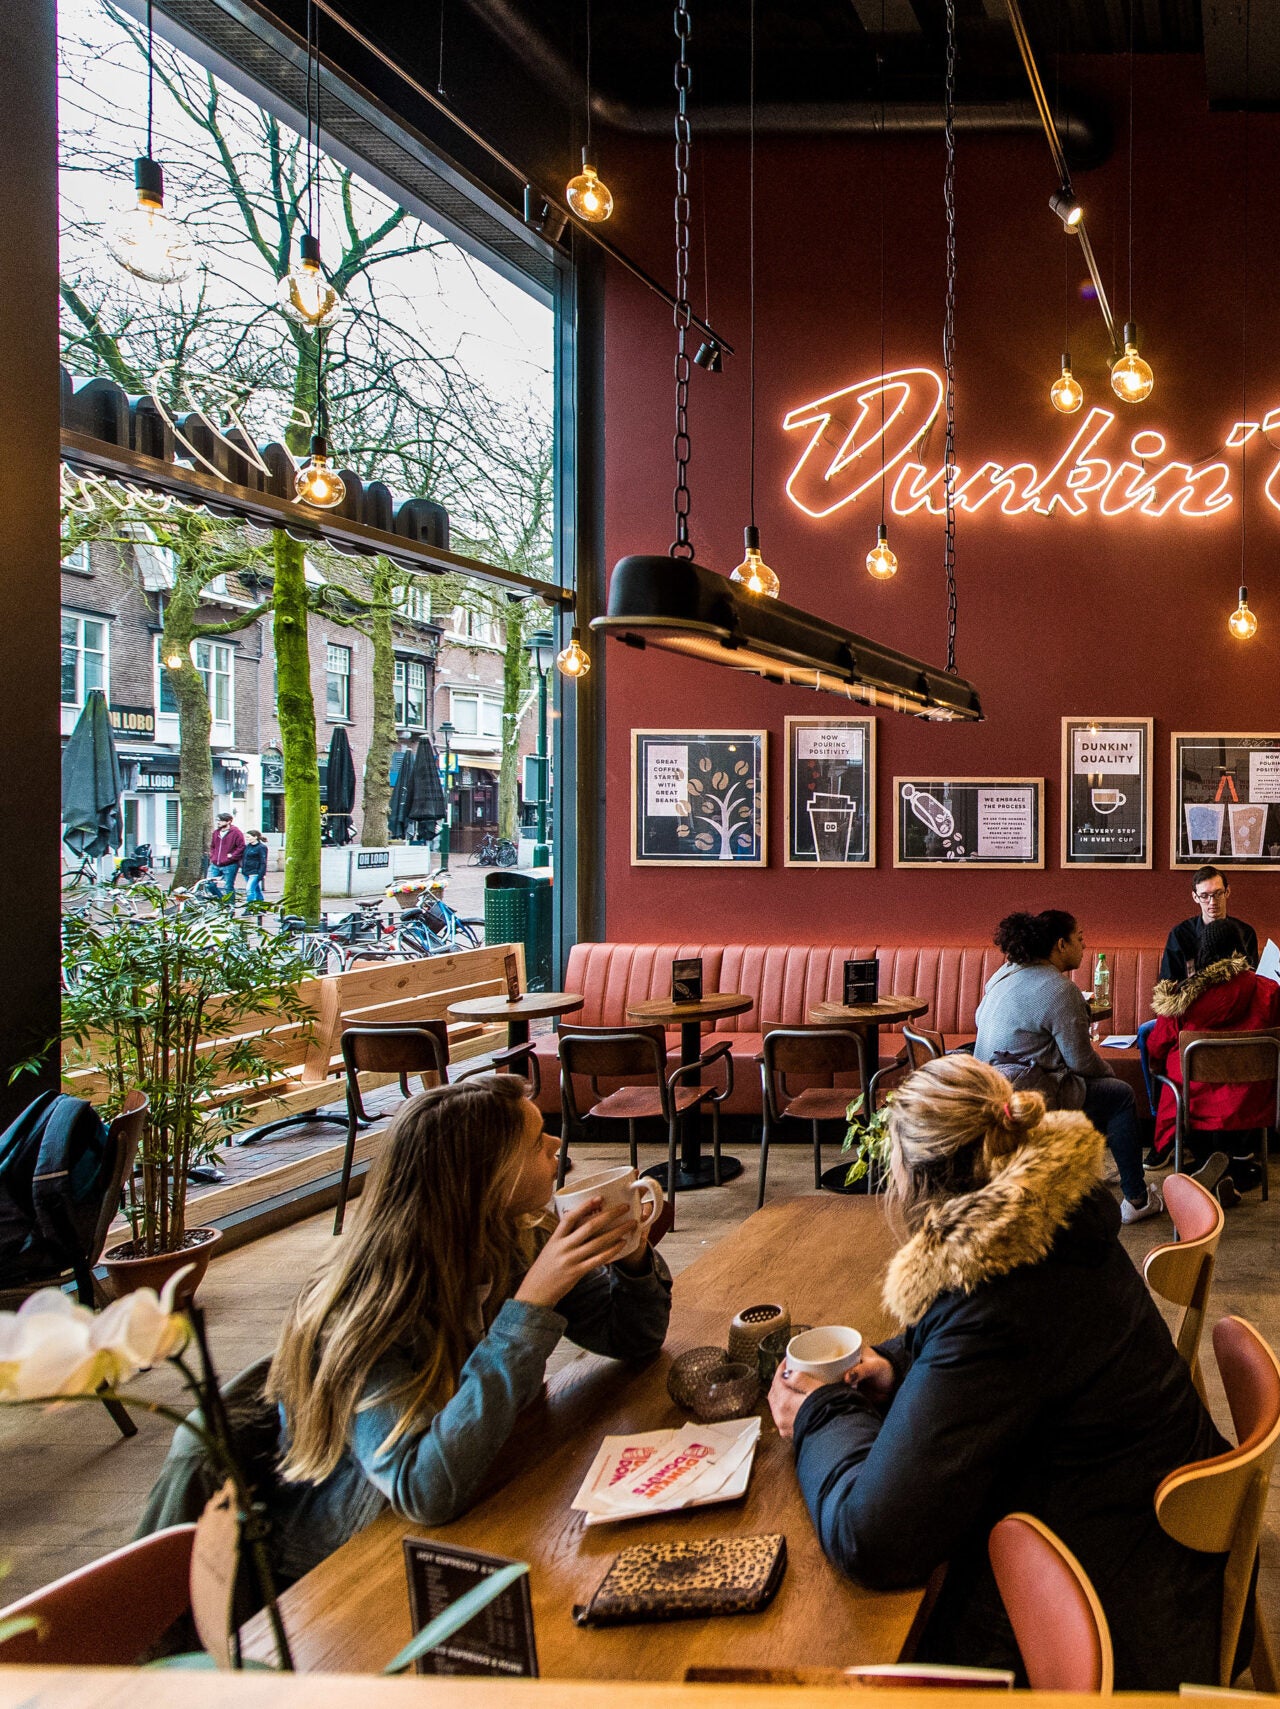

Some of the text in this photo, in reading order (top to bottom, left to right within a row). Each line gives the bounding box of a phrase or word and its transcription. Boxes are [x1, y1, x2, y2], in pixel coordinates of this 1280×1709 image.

[782, 367, 1259, 518] Dunkin'
[122, 712, 154, 731] LOBO
[1082, 742, 1132, 751] DUNKIN'
[1080, 755, 1133, 763] QUALITY
[150, 775, 174, 788] LOBO
[359, 853, 389, 865] OH LOBO
[632, 1455, 688, 1495] DONUTS
